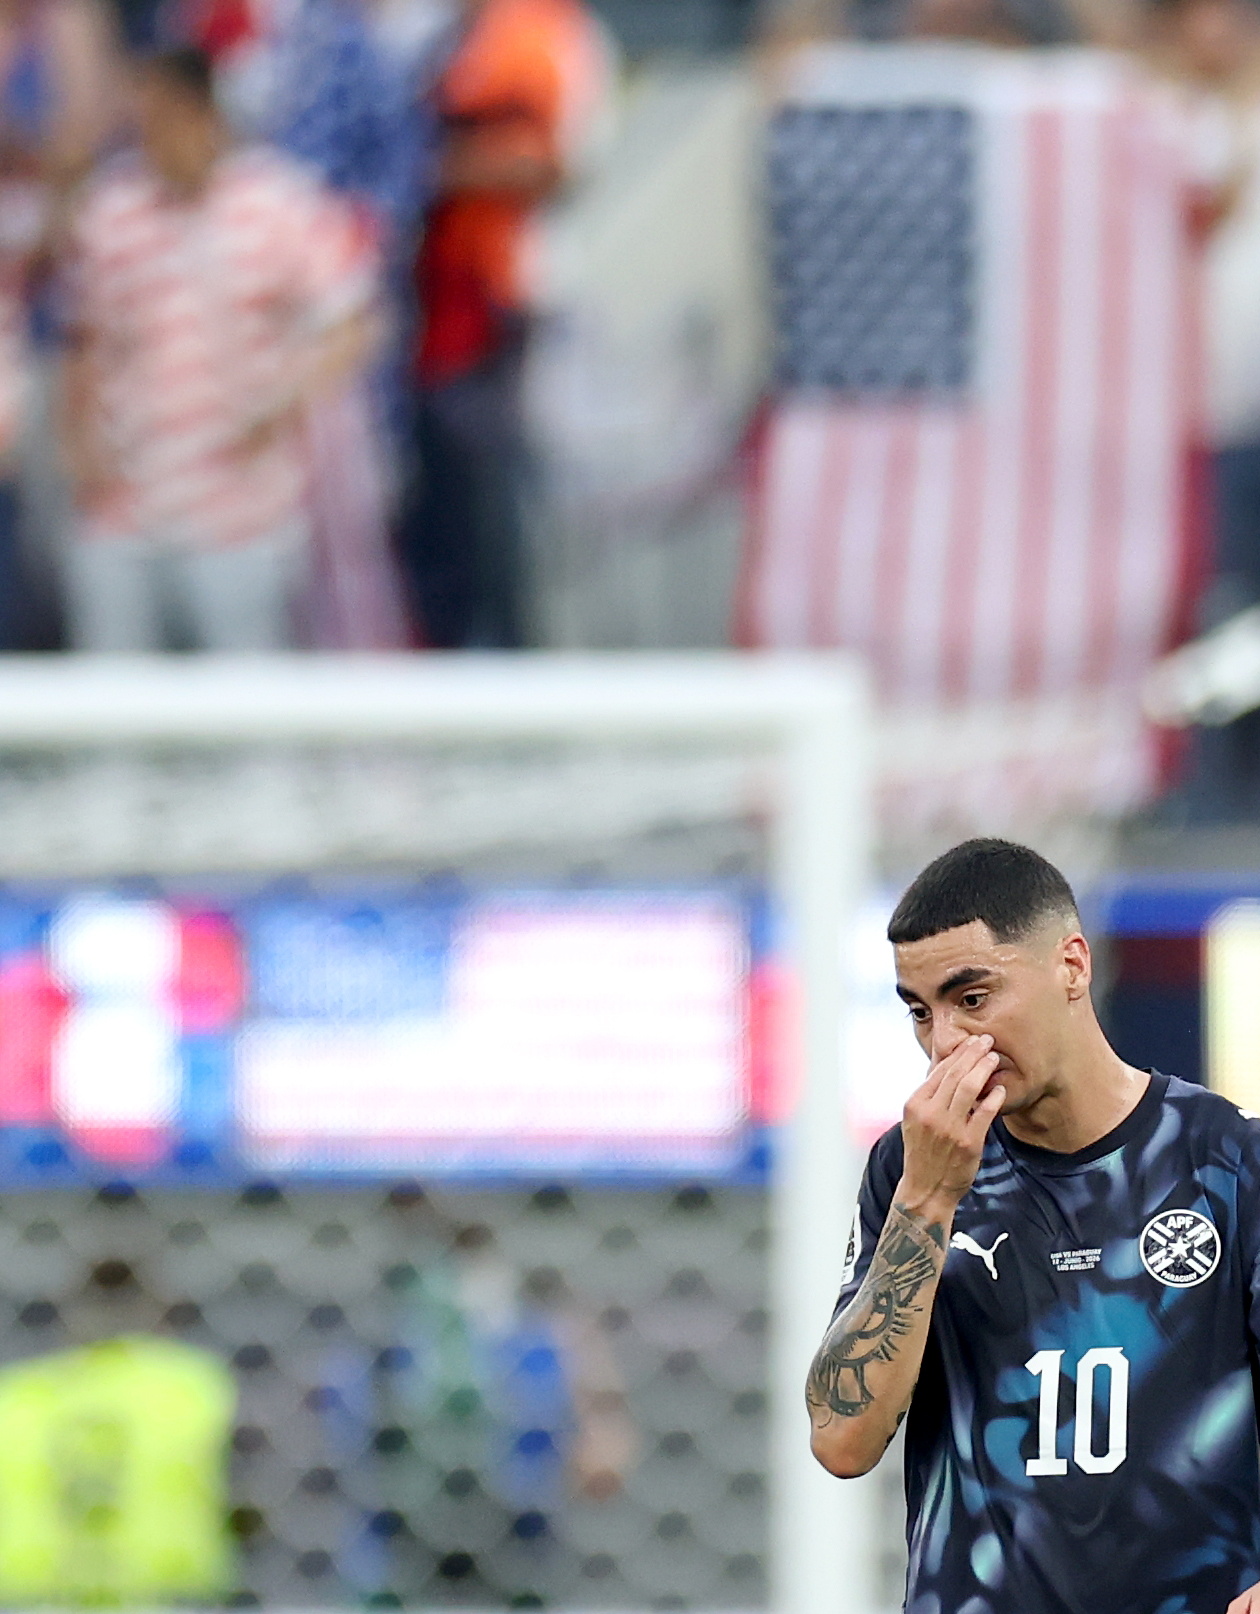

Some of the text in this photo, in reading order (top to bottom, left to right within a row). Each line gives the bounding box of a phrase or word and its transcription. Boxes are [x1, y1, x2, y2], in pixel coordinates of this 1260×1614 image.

[1167, 1216, 1194, 1228] APF
[1072, 1249, 1102, 1257] PARAGUAY
[1070, 1262, 1095, 1270] ANGELES
[1161, 1271, 1197, 1282] PARAGUAY
[1024, 1347, 1129, 1476] 10
